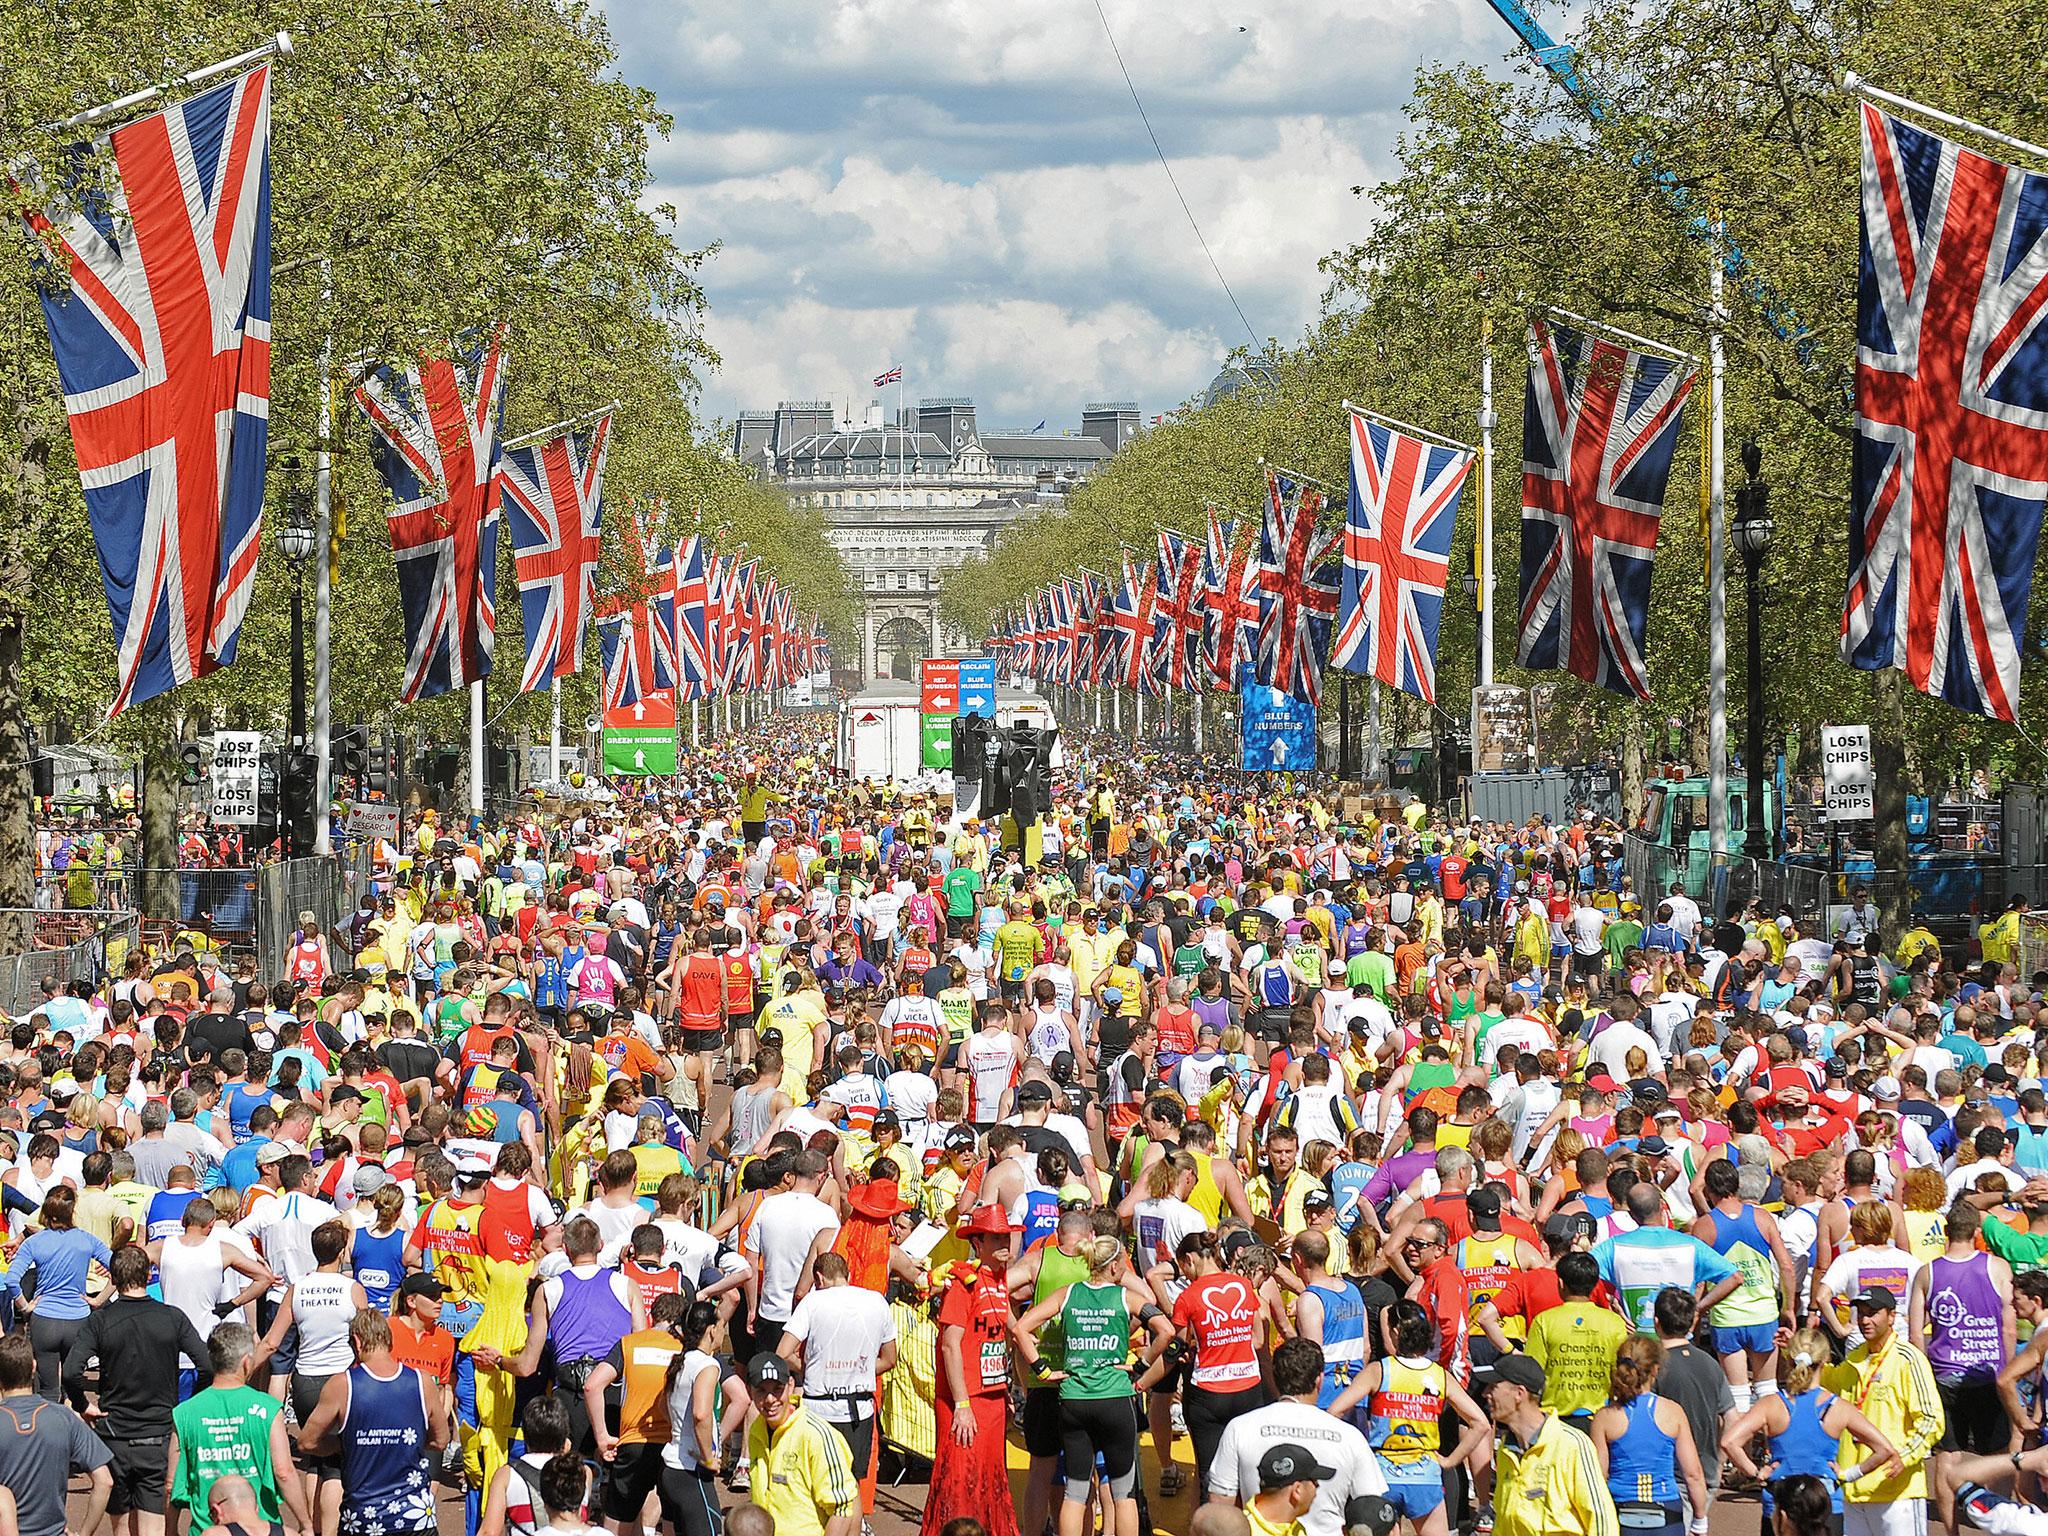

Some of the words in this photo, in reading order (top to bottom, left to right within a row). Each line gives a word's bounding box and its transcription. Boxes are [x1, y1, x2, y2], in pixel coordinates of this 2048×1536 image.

[1264, 712, 1291, 720] BLUE
[1254, 722, 1303, 730] NUMBERS
[220, 742, 253, 752] LOST
[1830, 736, 1864, 747] LOST
[214, 757, 257, 768] CHIPS
[1826, 751, 1869, 763] CHIPS
[218, 789, 252, 800] LOST
[1831, 783, 1867, 795] LOST
[1827, 798, 1871, 809] CHIPS
[213, 805, 256, 816] CHIPS
[362, 813, 386, 821] HEART
[352, 821, 392, 832] RESEARCH
[692, 971, 716, 980] DAVE
[941, 999, 969, 1008] MARY
[1338, 1186, 1360, 1222] 2
[429, 1228, 470, 1241] CHILDREN
[440, 1236, 456, 1245] with
[1463, 1265, 1511, 1277] CHILDREN
[300, 1286, 345, 1295] EVERYONE
[1963, 1314, 1998, 1327] Great
[436, 1320, 467, 1333] OLIN
[1206, 1328, 1233, 1340] British
[1948, 1326, 1999, 1339] Ormond
[1066, 1334, 1120, 1351] teamGO
[1206, 1334, 1252, 1347] Foundation
[1962, 1338, 2000, 1350] Street
[1559, 1343, 1606, 1356] Changing
[1950, 1348, 2001, 1363] Hospital
[396, 1357, 438, 1369] KATRINA
[1402, 1403, 1422, 1413] with
[368, 1428, 402, 1437] ANTHONY
[1260, 1424, 1342, 1443] SHOULDERS
[356, 1437, 382, 1445] NOLAN
[197, 1443, 251, 1462] teamGO
